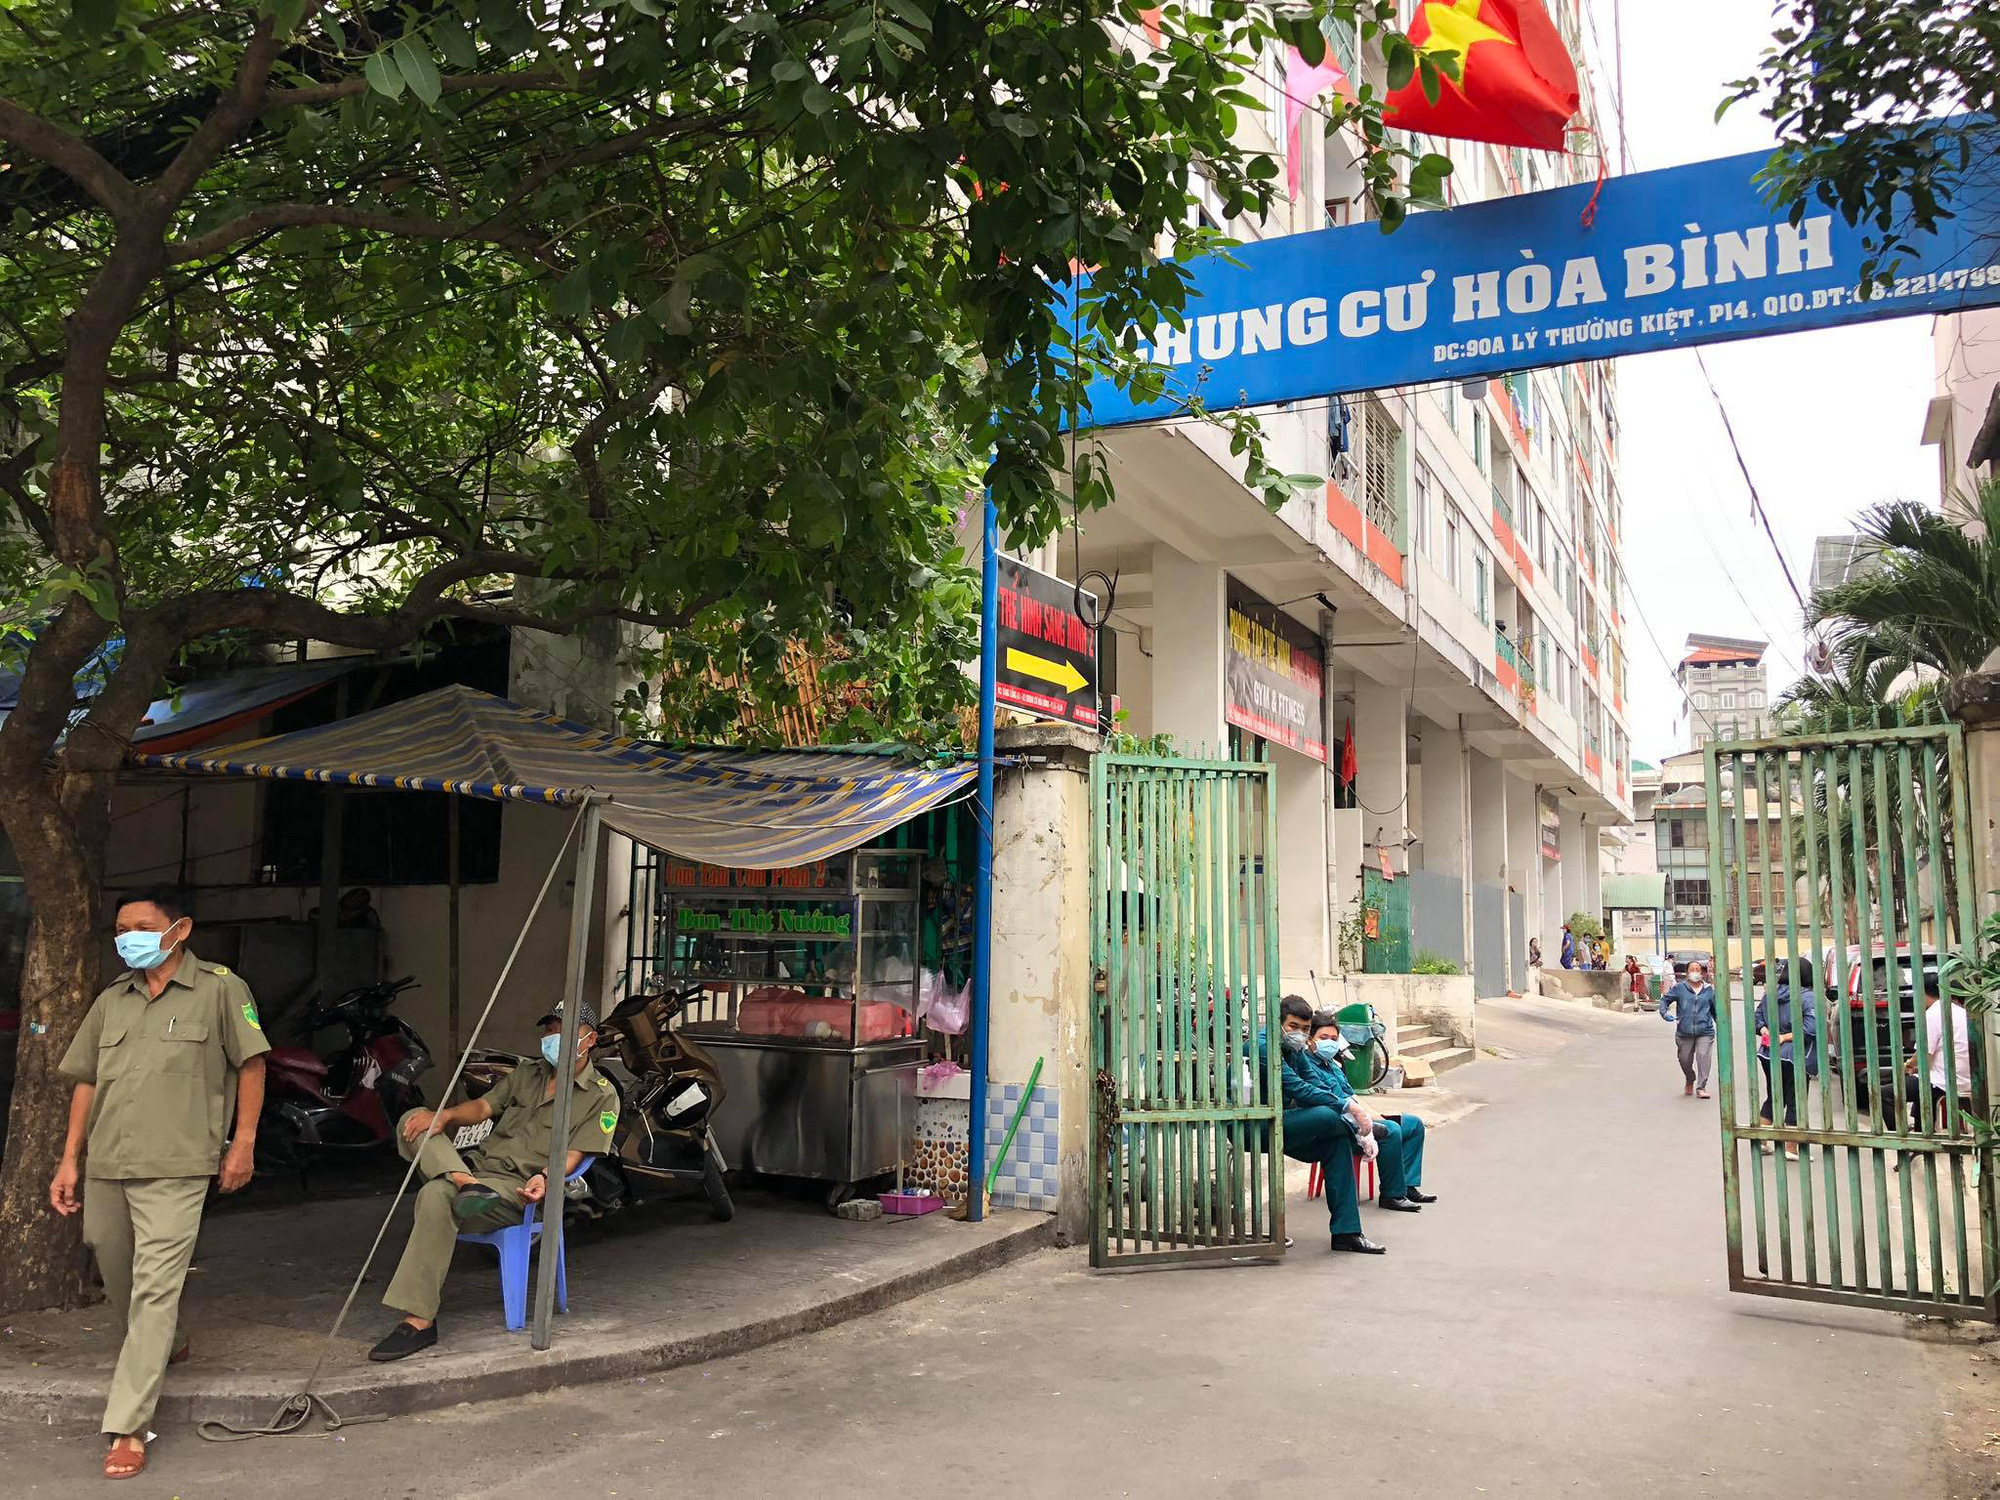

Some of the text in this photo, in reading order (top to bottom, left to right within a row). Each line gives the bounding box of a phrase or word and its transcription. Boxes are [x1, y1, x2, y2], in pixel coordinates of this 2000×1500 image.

[1338, 269, 1435, 338] CƯ
[1452, 249, 1608, 323] HÒA
[1624, 215, 1833, 299] BÌNH
[1512, 327, 1538, 351] LÝ
[1546, 317, 1633, 347] THƯỜNG
[1253, 679, 1270, 711] GYM
[1278, 691, 1305, 727] FITNESS
